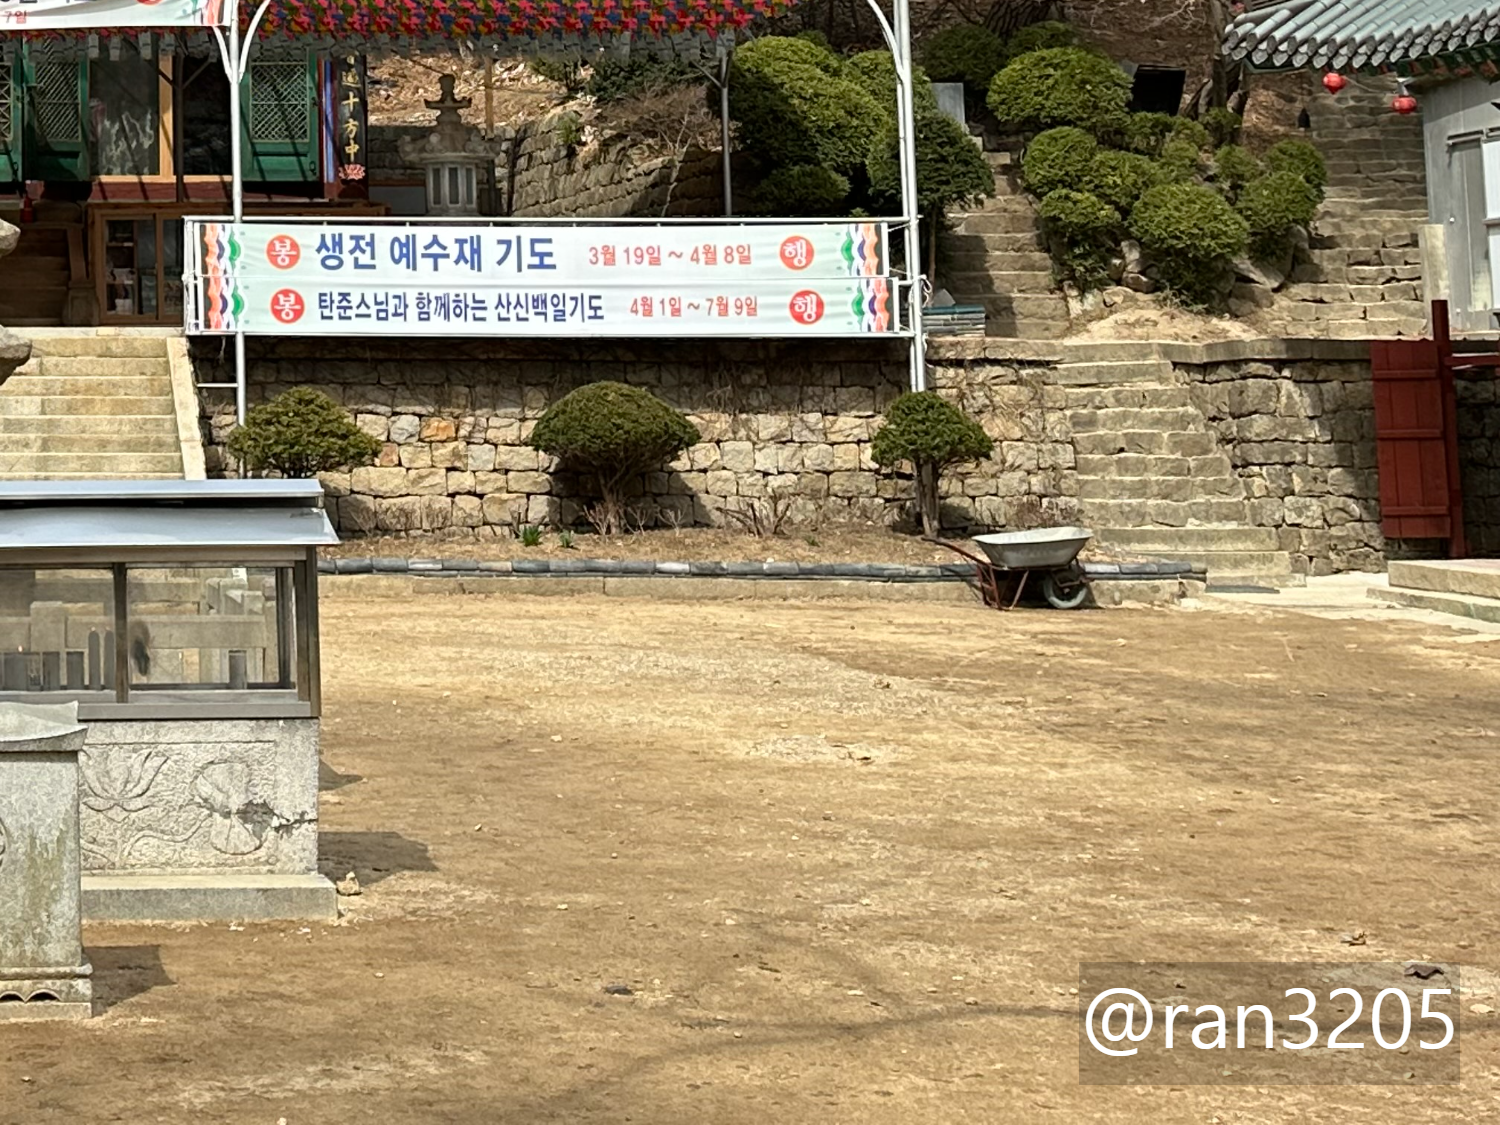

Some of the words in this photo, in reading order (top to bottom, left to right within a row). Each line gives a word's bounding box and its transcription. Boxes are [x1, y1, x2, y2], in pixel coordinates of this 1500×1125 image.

[4, 10, 27, 24] 7일
[270, 238, 297, 266] 봉
[315, 232, 377, 271] 생전
[390, 232, 482, 272] 예수재
[496, 235, 557, 272] 기도
[589, 244, 616, 267] 3월
[623, 244, 662, 266] 19일
[690, 244, 718, 266] 4월
[724, 243, 752, 265] 8일
[783, 239, 808, 267] 행
[274, 292, 301, 320] 봉
[318, 291, 409, 322] 탄준스님과
[415, 291, 488, 322] 함께하는
[494, 292, 604, 323] 산신백일기도
[630, 296, 654, 317] 4월
[659, 296, 681, 317] 1일
[705, 296, 729, 317] 7월
[734, 296, 758, 317] 9일
[793, 293, 817, 322] 행
